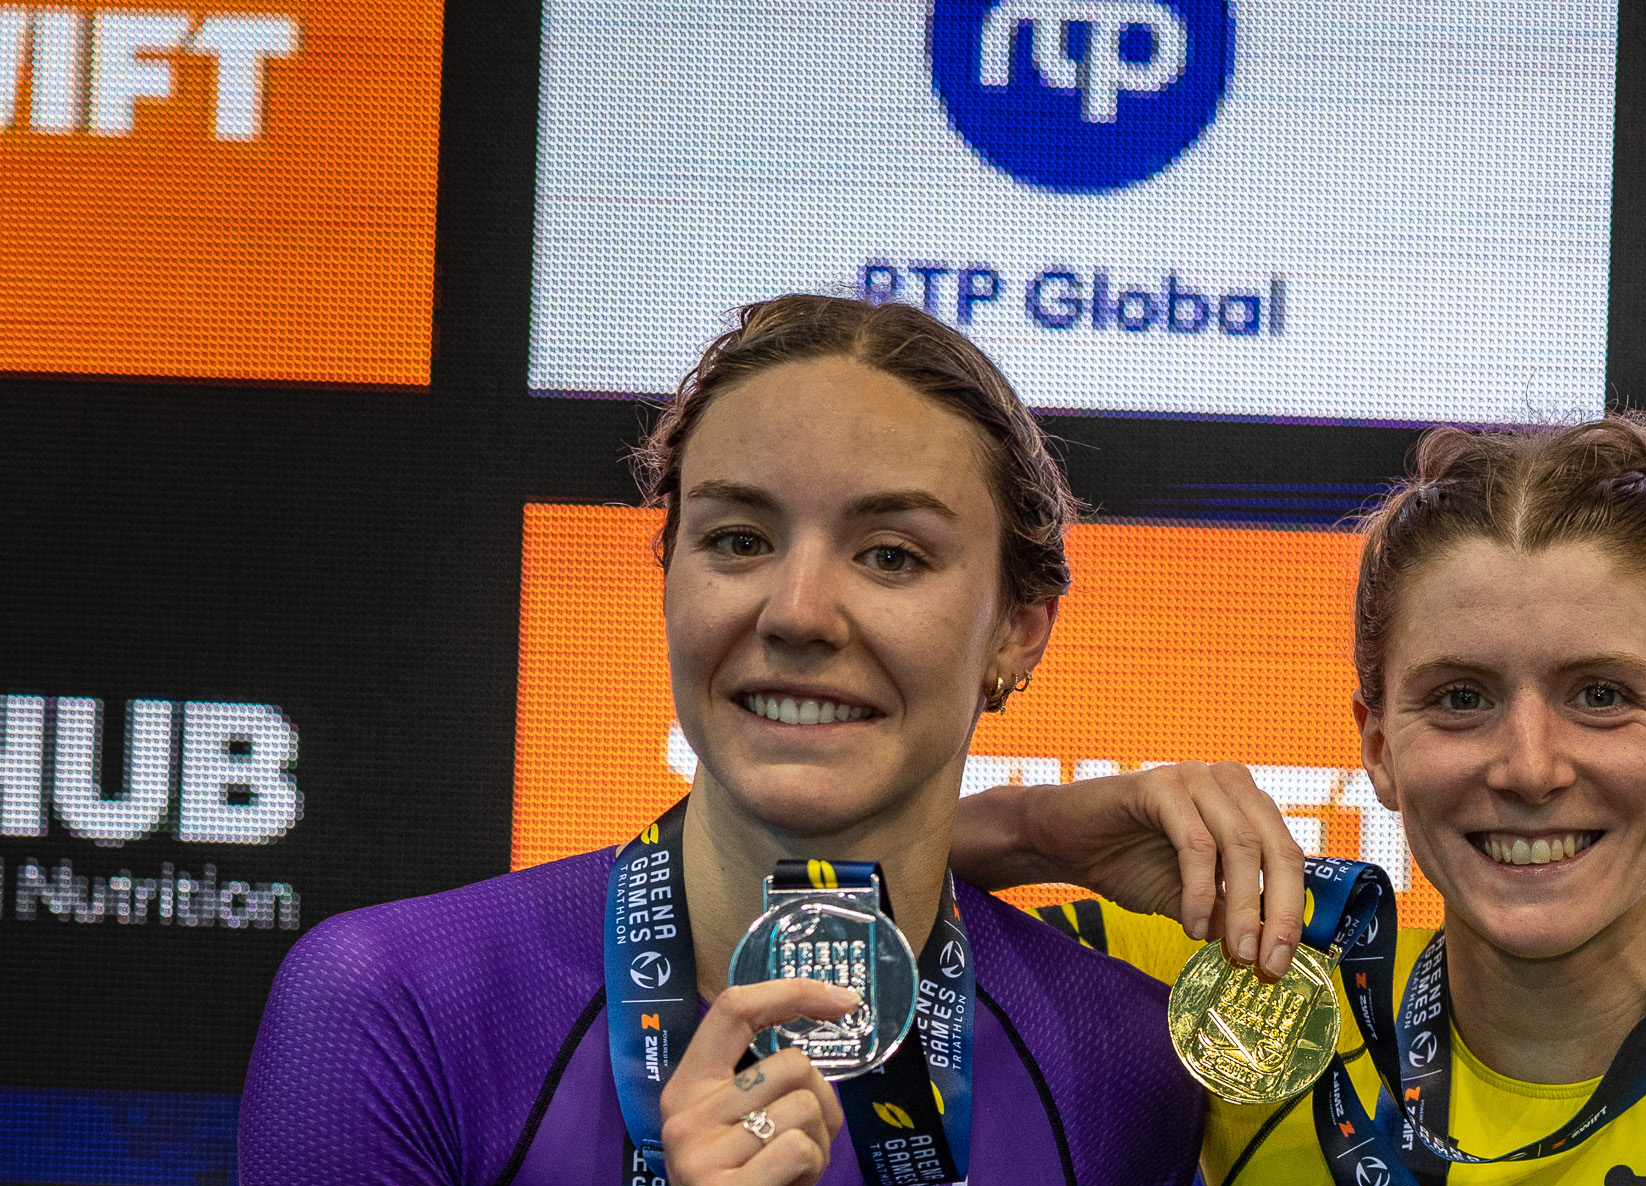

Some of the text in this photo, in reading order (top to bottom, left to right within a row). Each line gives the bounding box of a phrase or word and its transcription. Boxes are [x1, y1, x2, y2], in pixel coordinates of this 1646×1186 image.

[1024, 264, 1287, 338] Global
[616, 864, 629, 945] TRIATHLON
[628, 856, 651, 943] GAMES
[650, 850, 677, 940] ARENA
[1359, 994, 1378, 1041] ZWIFT
[1412, 943, 1436, 1026] GAMES
[1428, 935, 1446, 1019] ARENA
[645, 1035, 661, 1082] ZWIFT
[930, 988, 957, 1069] GAMES
[952, 994, 967, 1070] TRIATHLON
[1333, 1071, 1345, 1117] ZWIFT
